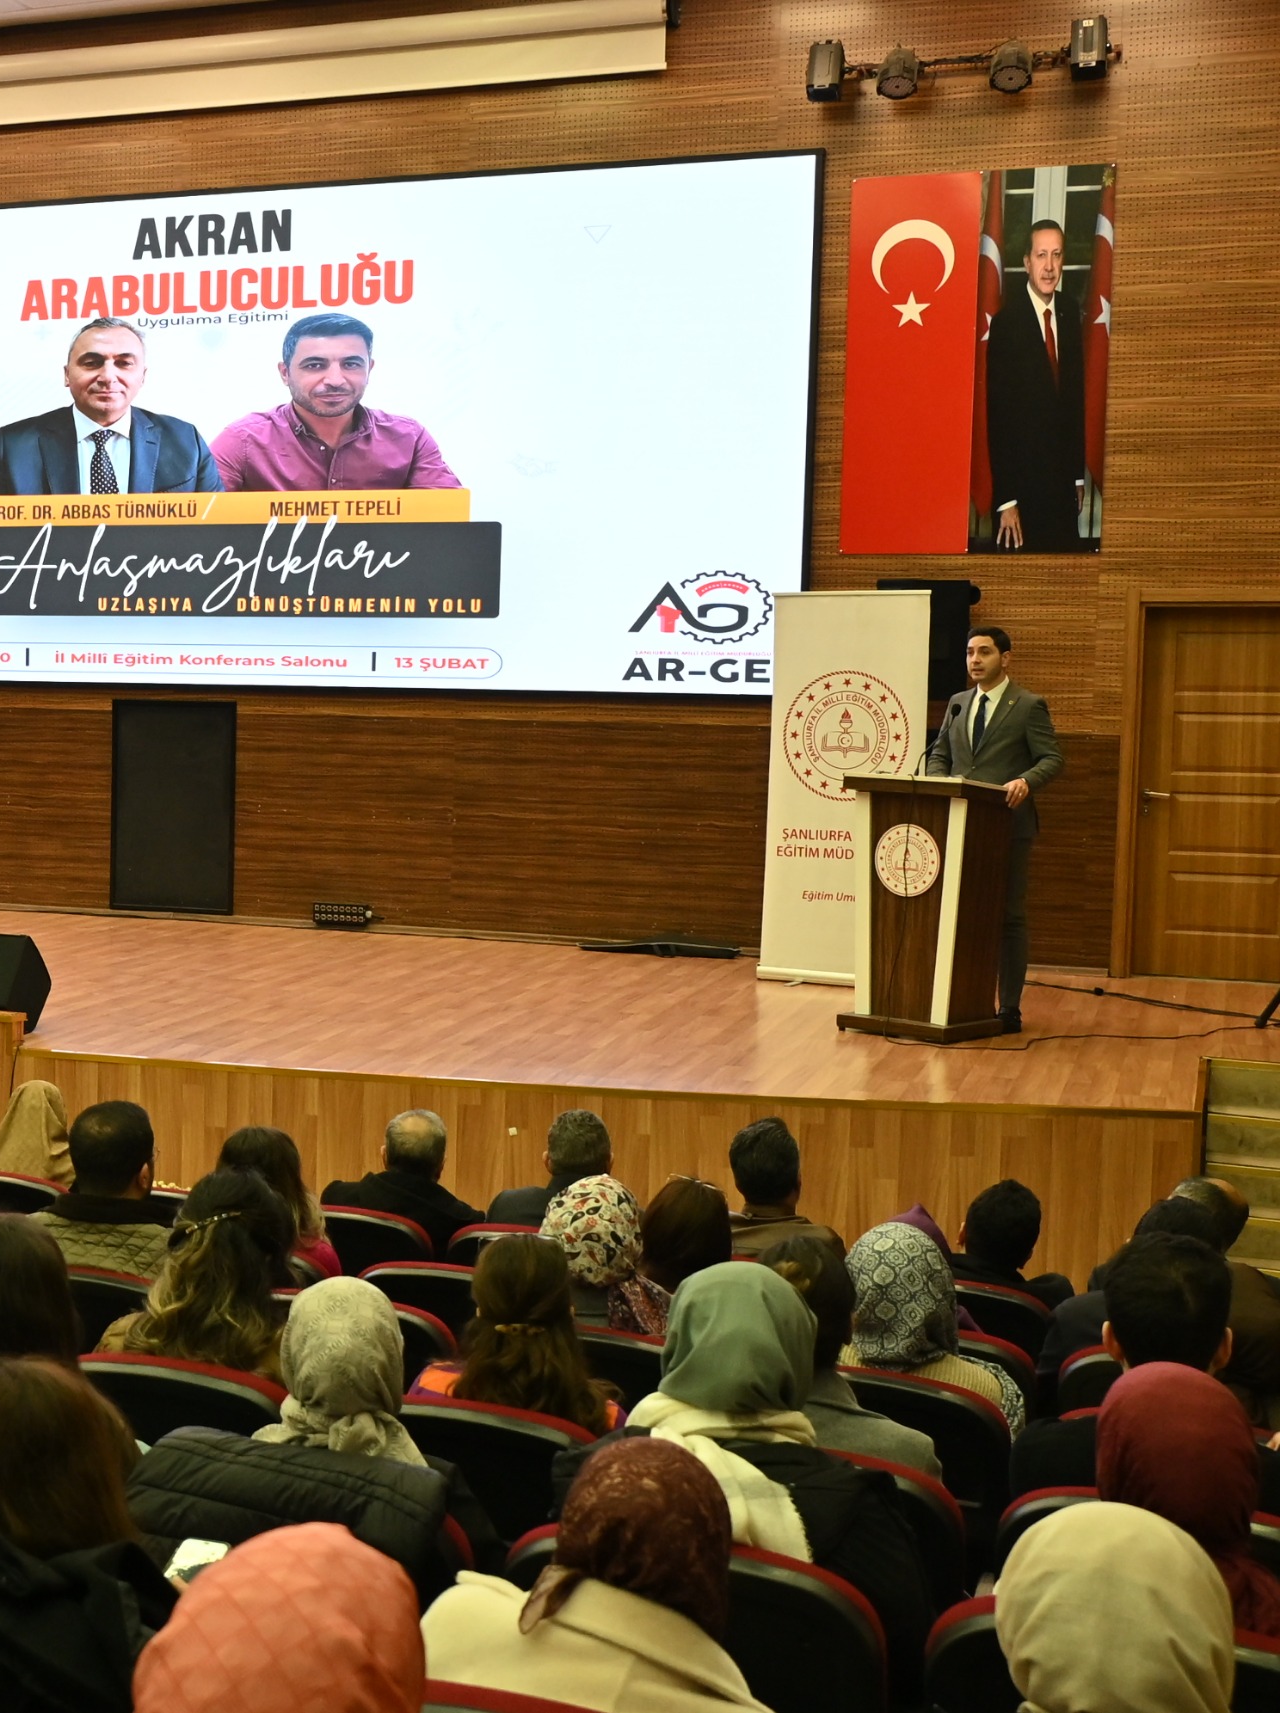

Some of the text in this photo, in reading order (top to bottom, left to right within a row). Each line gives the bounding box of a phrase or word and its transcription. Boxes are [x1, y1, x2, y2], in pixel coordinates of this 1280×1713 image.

[132, 208, 292, 260] AKRAN
[20, 252, 414, 322] ARABULUCULUĞU
[137, 310, 289, 330] Uygulama Eğitimi
[32, 504, 56, 520] DR.
[61, 503, 111, 520] ABBAS
[116, 500, 198, 519] TÜRNÜKLÜ
[269, 497, 402, 517] MEHMET TEPELİ
[97, 595, 483, 615] UZLAŞIYA DÖNÜŞTÜRMENİN YOLU
[55, 651, 65, 664] İl
[114, 652, 173, 668] Eğitim
[179, 653, 275, 668] Konferans
[281, 655, 348, 669] Salonu
[394, 657, 413, 669] 13
[419, 657, 489, 672] ŞUBAT
[622, 657, 771, 684] AR-GE
[805, 715, 820, 763] ŞANLIURFA
[814, 706, 823, 716] İL
[845, 692, 874, 711] EĞİTİM
[870, 708, 888, 766] MÜDÜRLÜĞÜ
[782, 828, 852, 842] ŞANLIURFA
[776, 844, 855, 860] EĞİTİM MÜD
[802, 890, 834, 902] Eğitim
